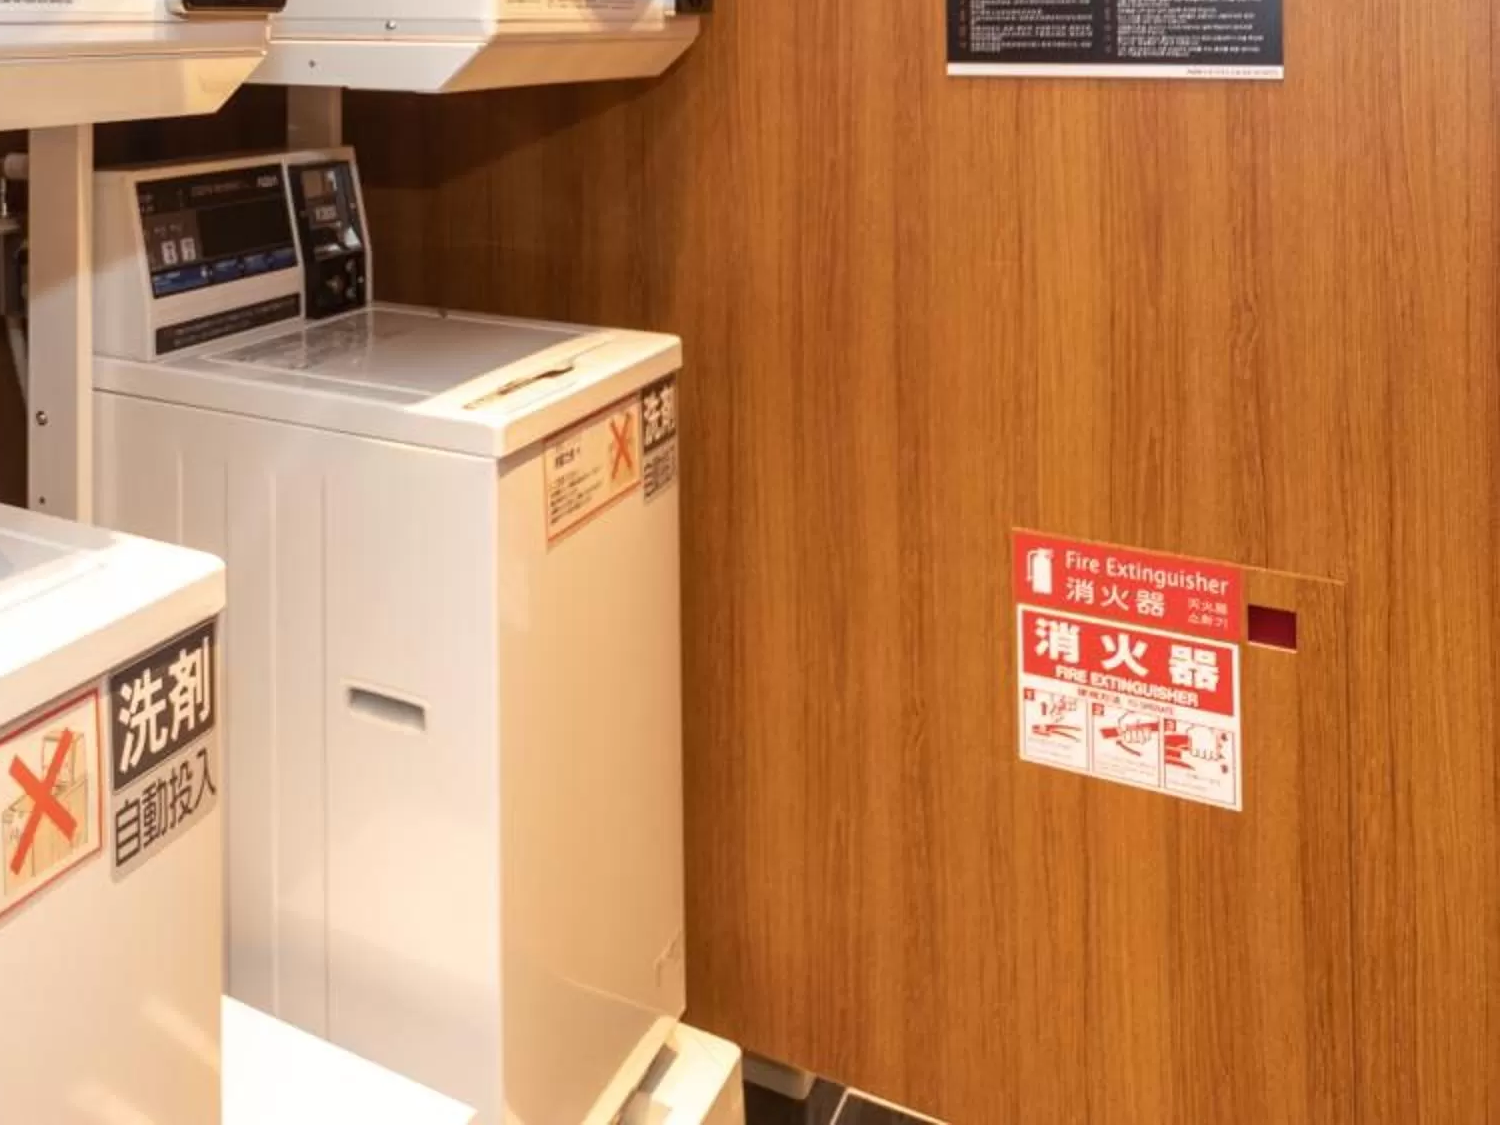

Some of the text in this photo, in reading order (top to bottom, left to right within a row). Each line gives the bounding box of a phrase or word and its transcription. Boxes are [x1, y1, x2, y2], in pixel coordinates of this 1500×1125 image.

[1065, 550, 1229, 595] Fire Extinguisher
[1066, 577, 1165, 618] 消火器
[1035, 618, 1219, 692] 消火器
[117, 636, 213, 774] 洗剤
[1055, 665, 1199, 707] FIRE EXTINGUISHER
[114, 746, 218, 870] 自動投入
